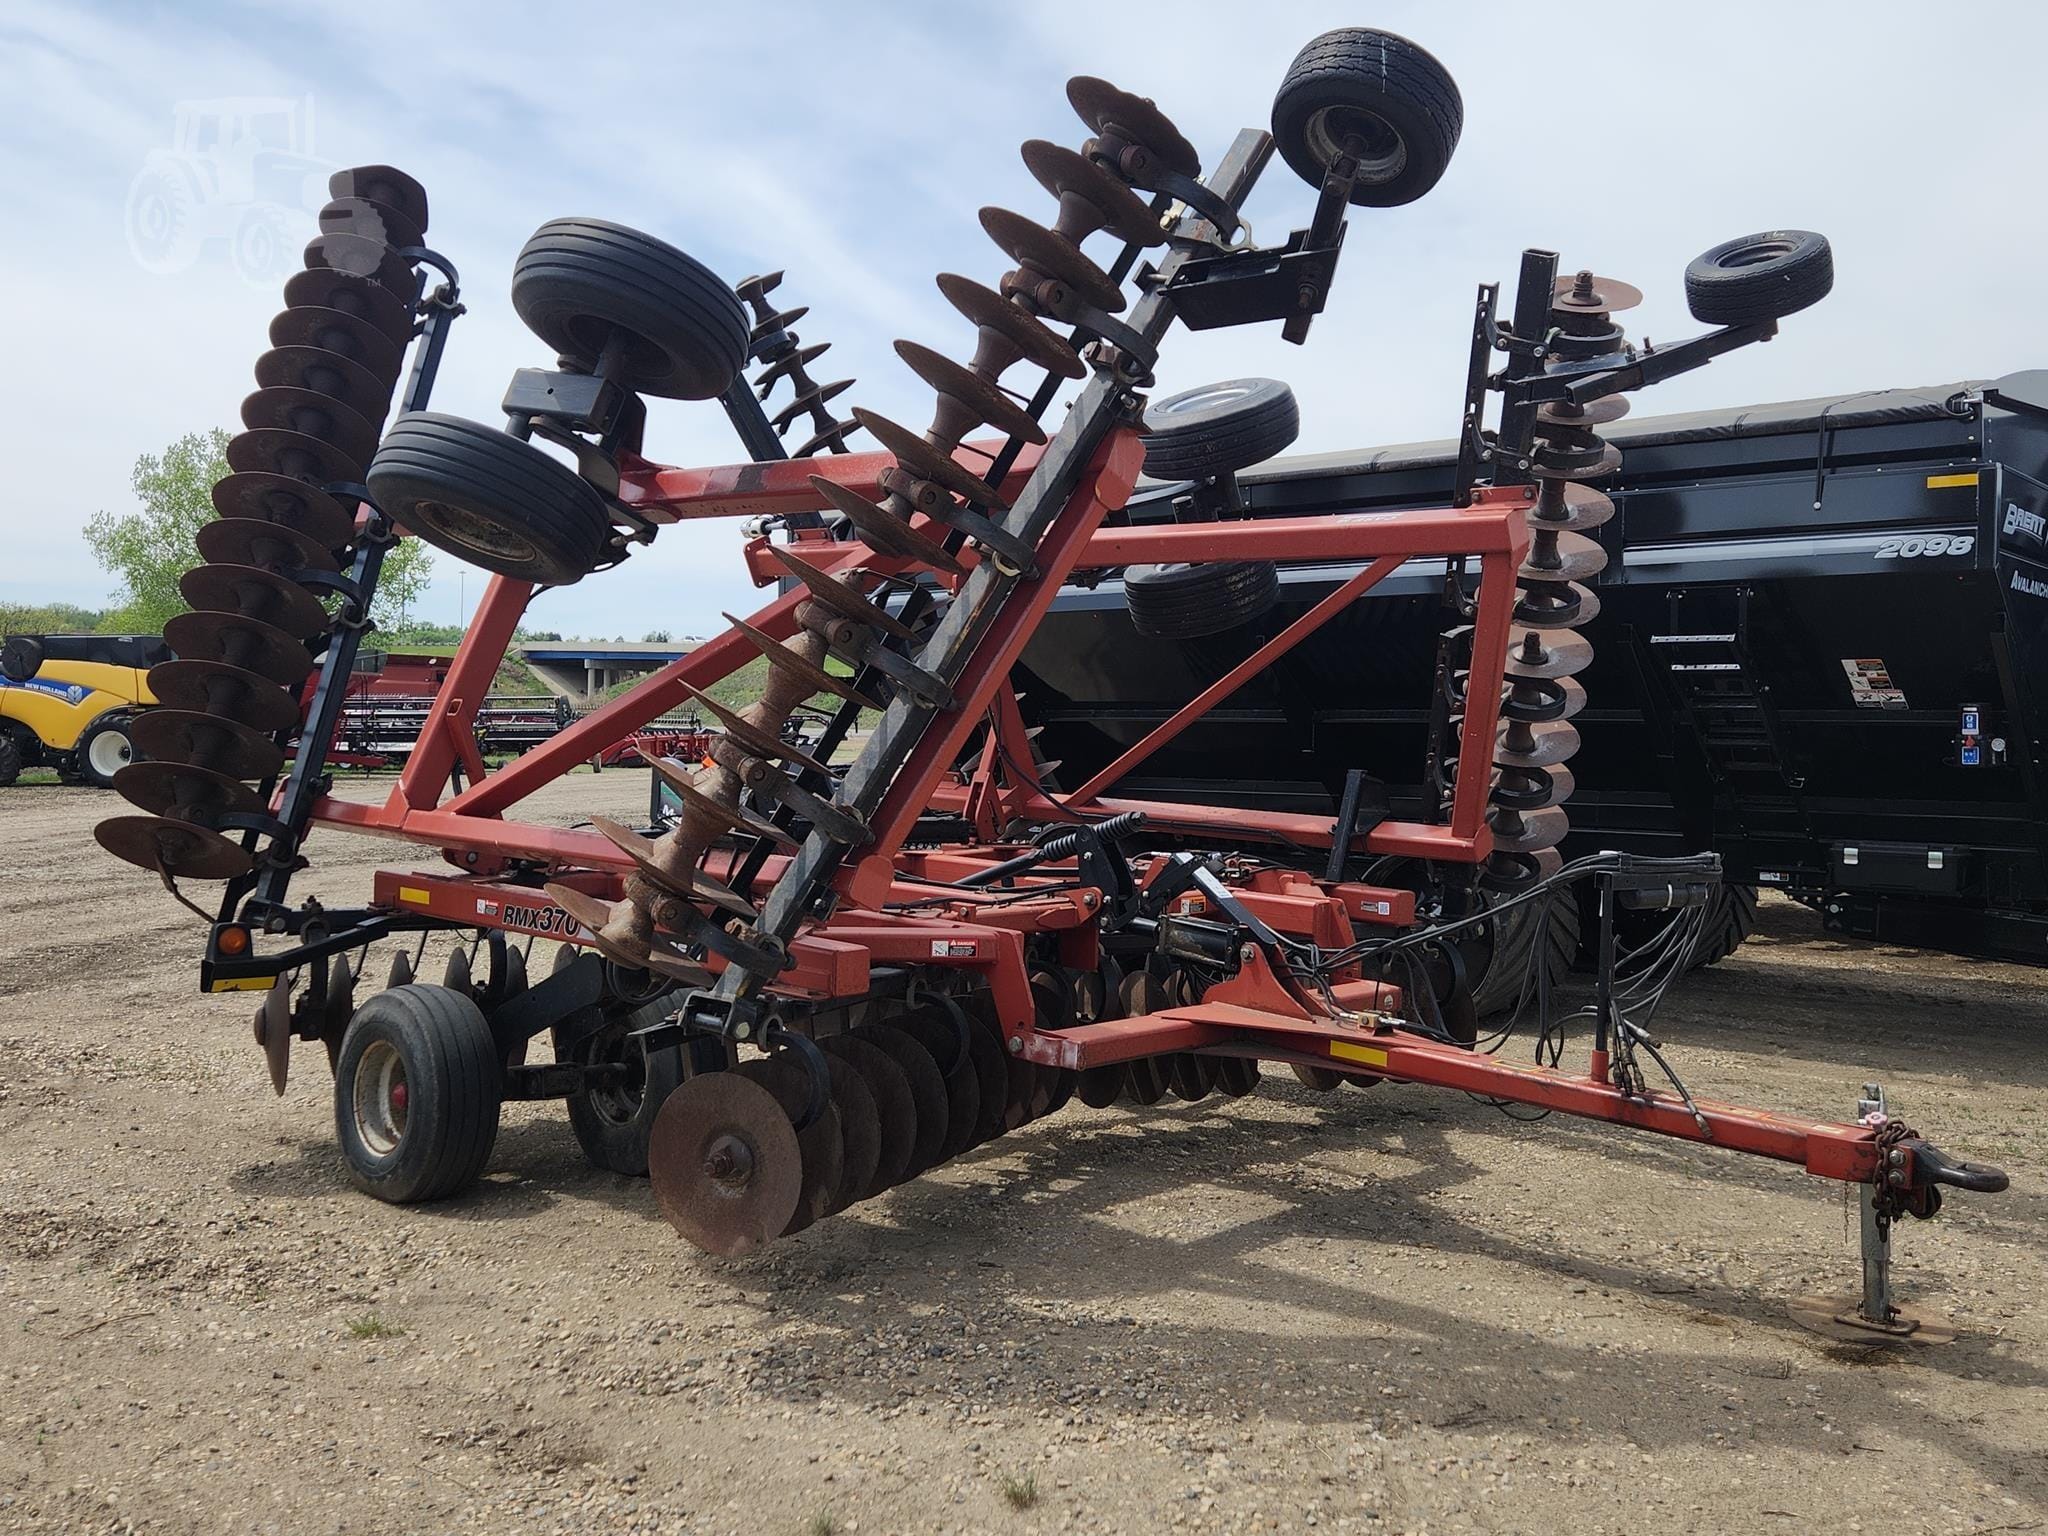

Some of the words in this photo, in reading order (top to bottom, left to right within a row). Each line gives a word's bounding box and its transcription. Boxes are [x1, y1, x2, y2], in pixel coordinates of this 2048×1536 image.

[2003, 503, 2046, 535] BRENT
[1873, 535, 1976, 559] 2098
[502, 904, 581, 936] RMX370
